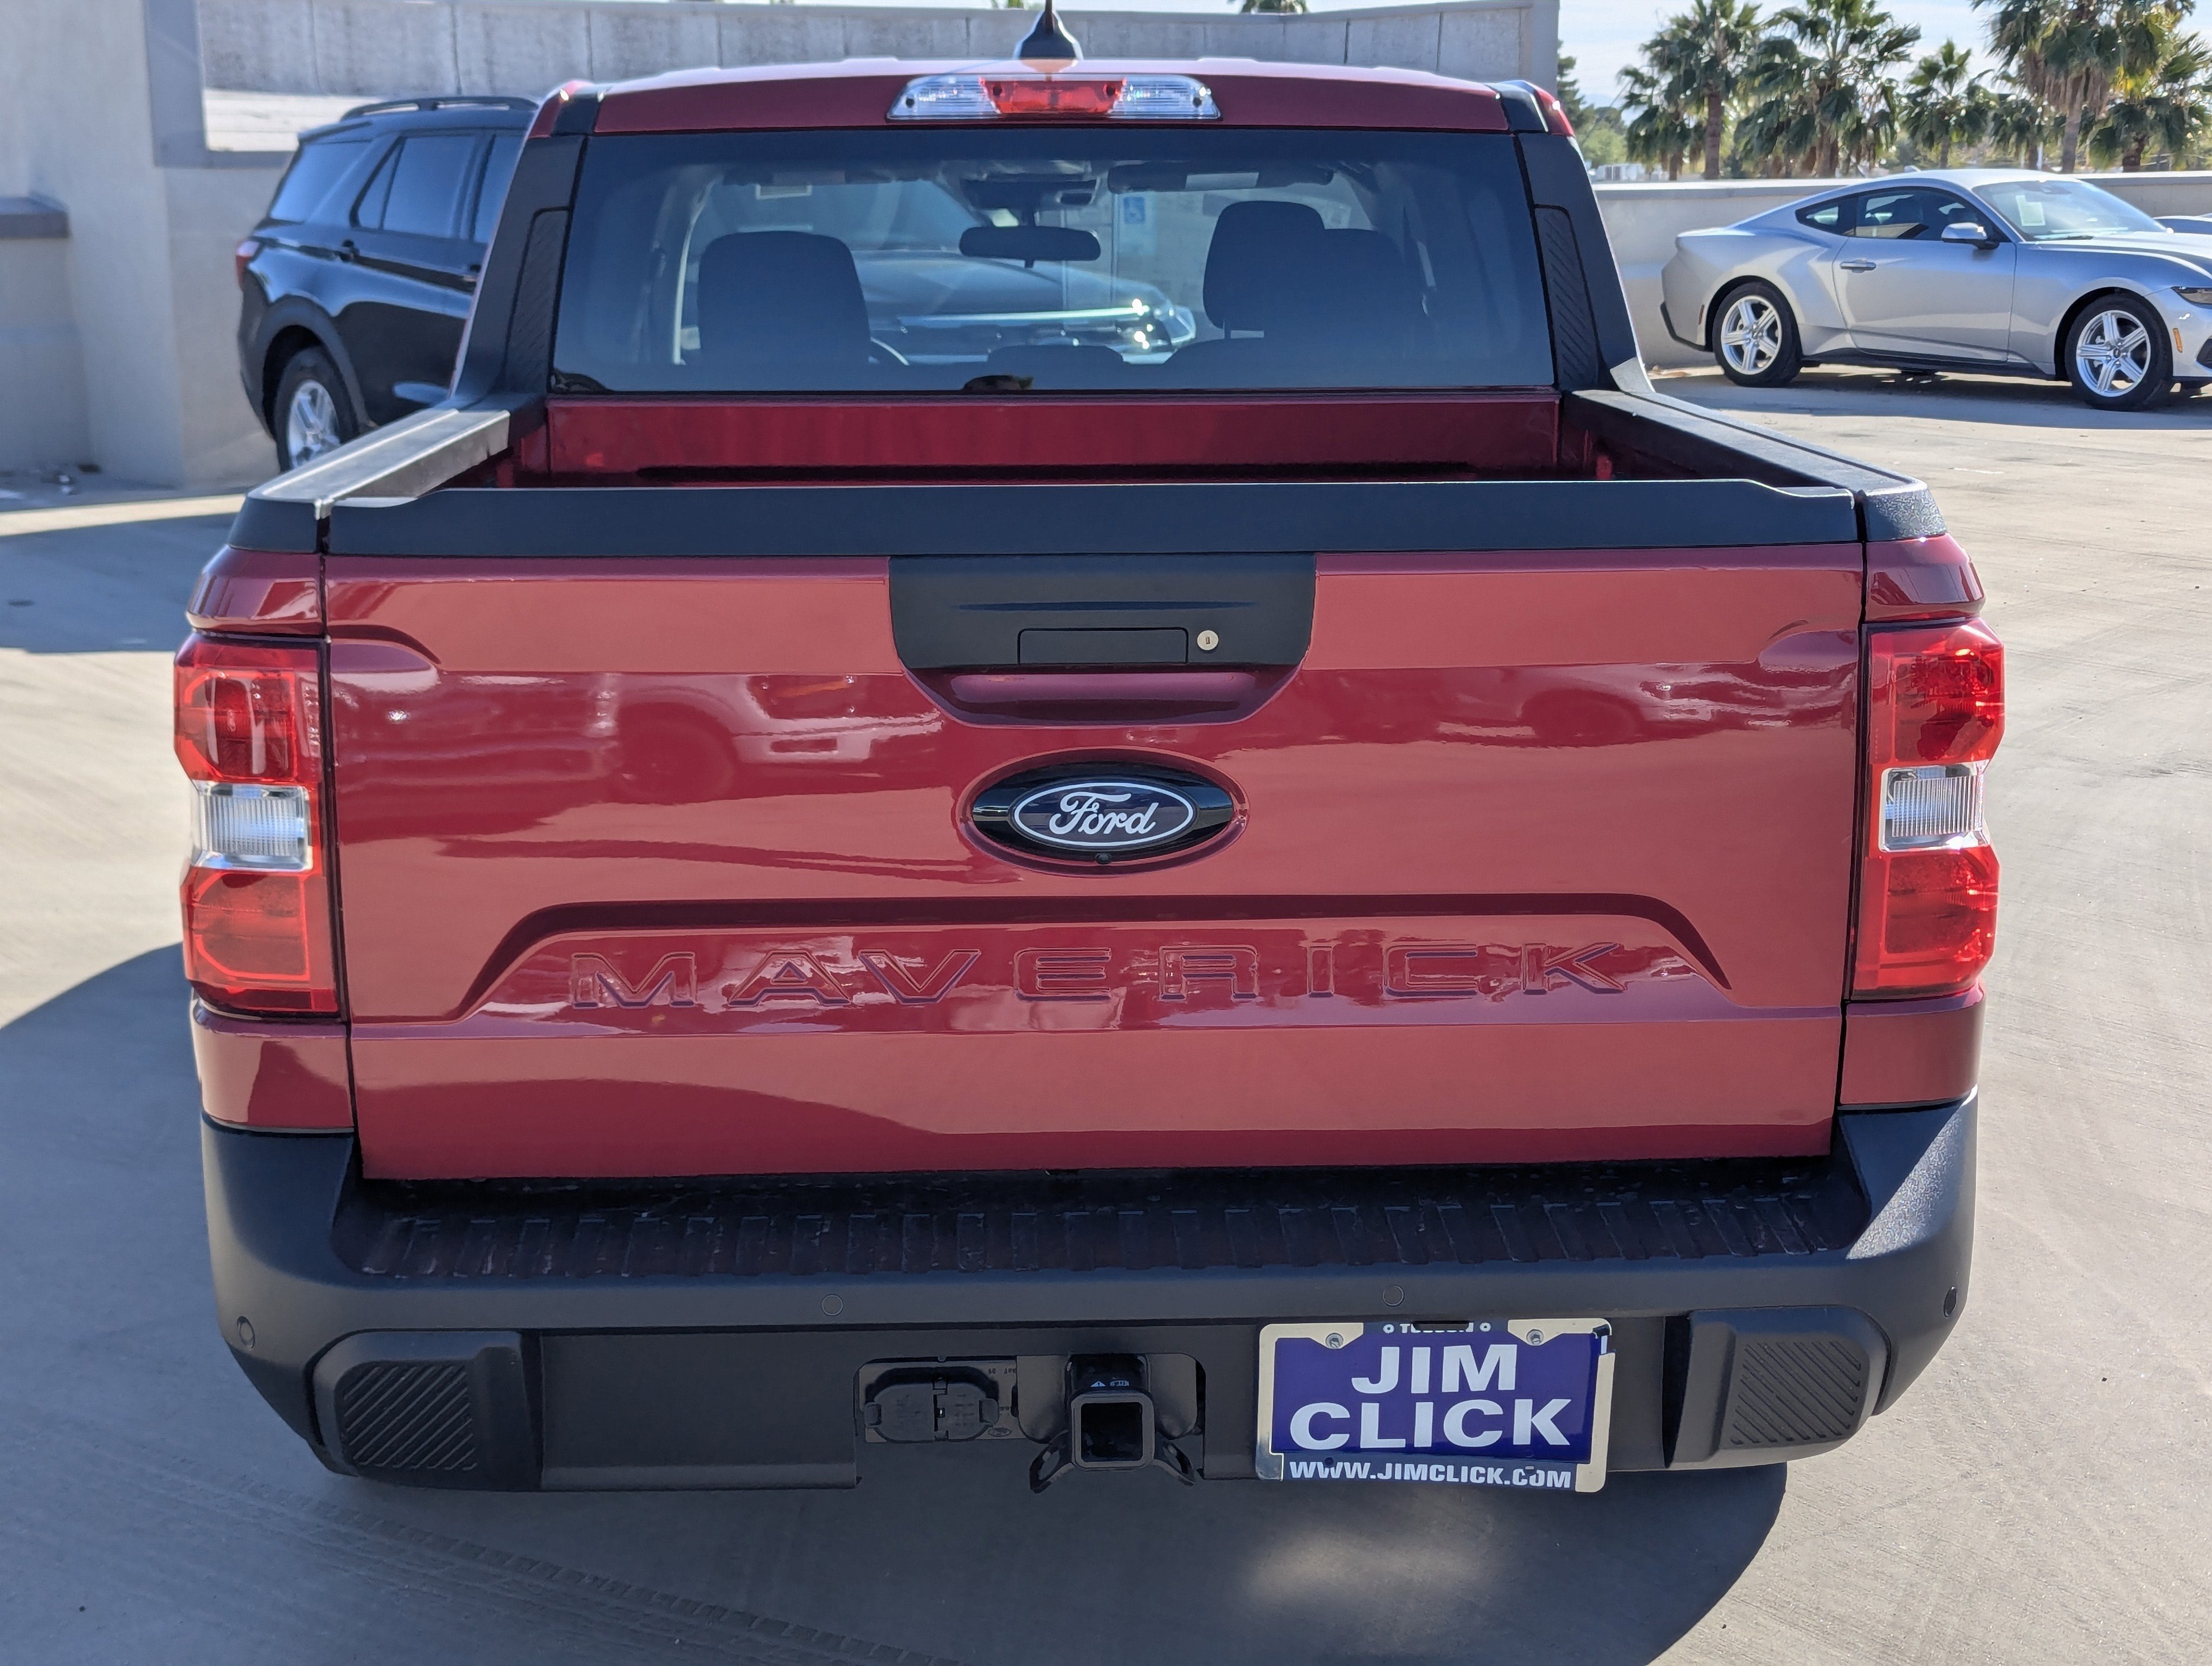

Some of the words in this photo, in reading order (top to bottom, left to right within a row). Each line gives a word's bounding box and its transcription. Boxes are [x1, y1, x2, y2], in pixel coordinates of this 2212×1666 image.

[1049, 792, 1159, 834] Ford
[571, 943, 1627, 1009] MAVERICK
[1352, 1344, 1517, 1393] JIM
[1290, 1399, 1571, 1450] CLICK
[1289, 1462, 1571, 1488] WWW.JIMCLICK.COM
